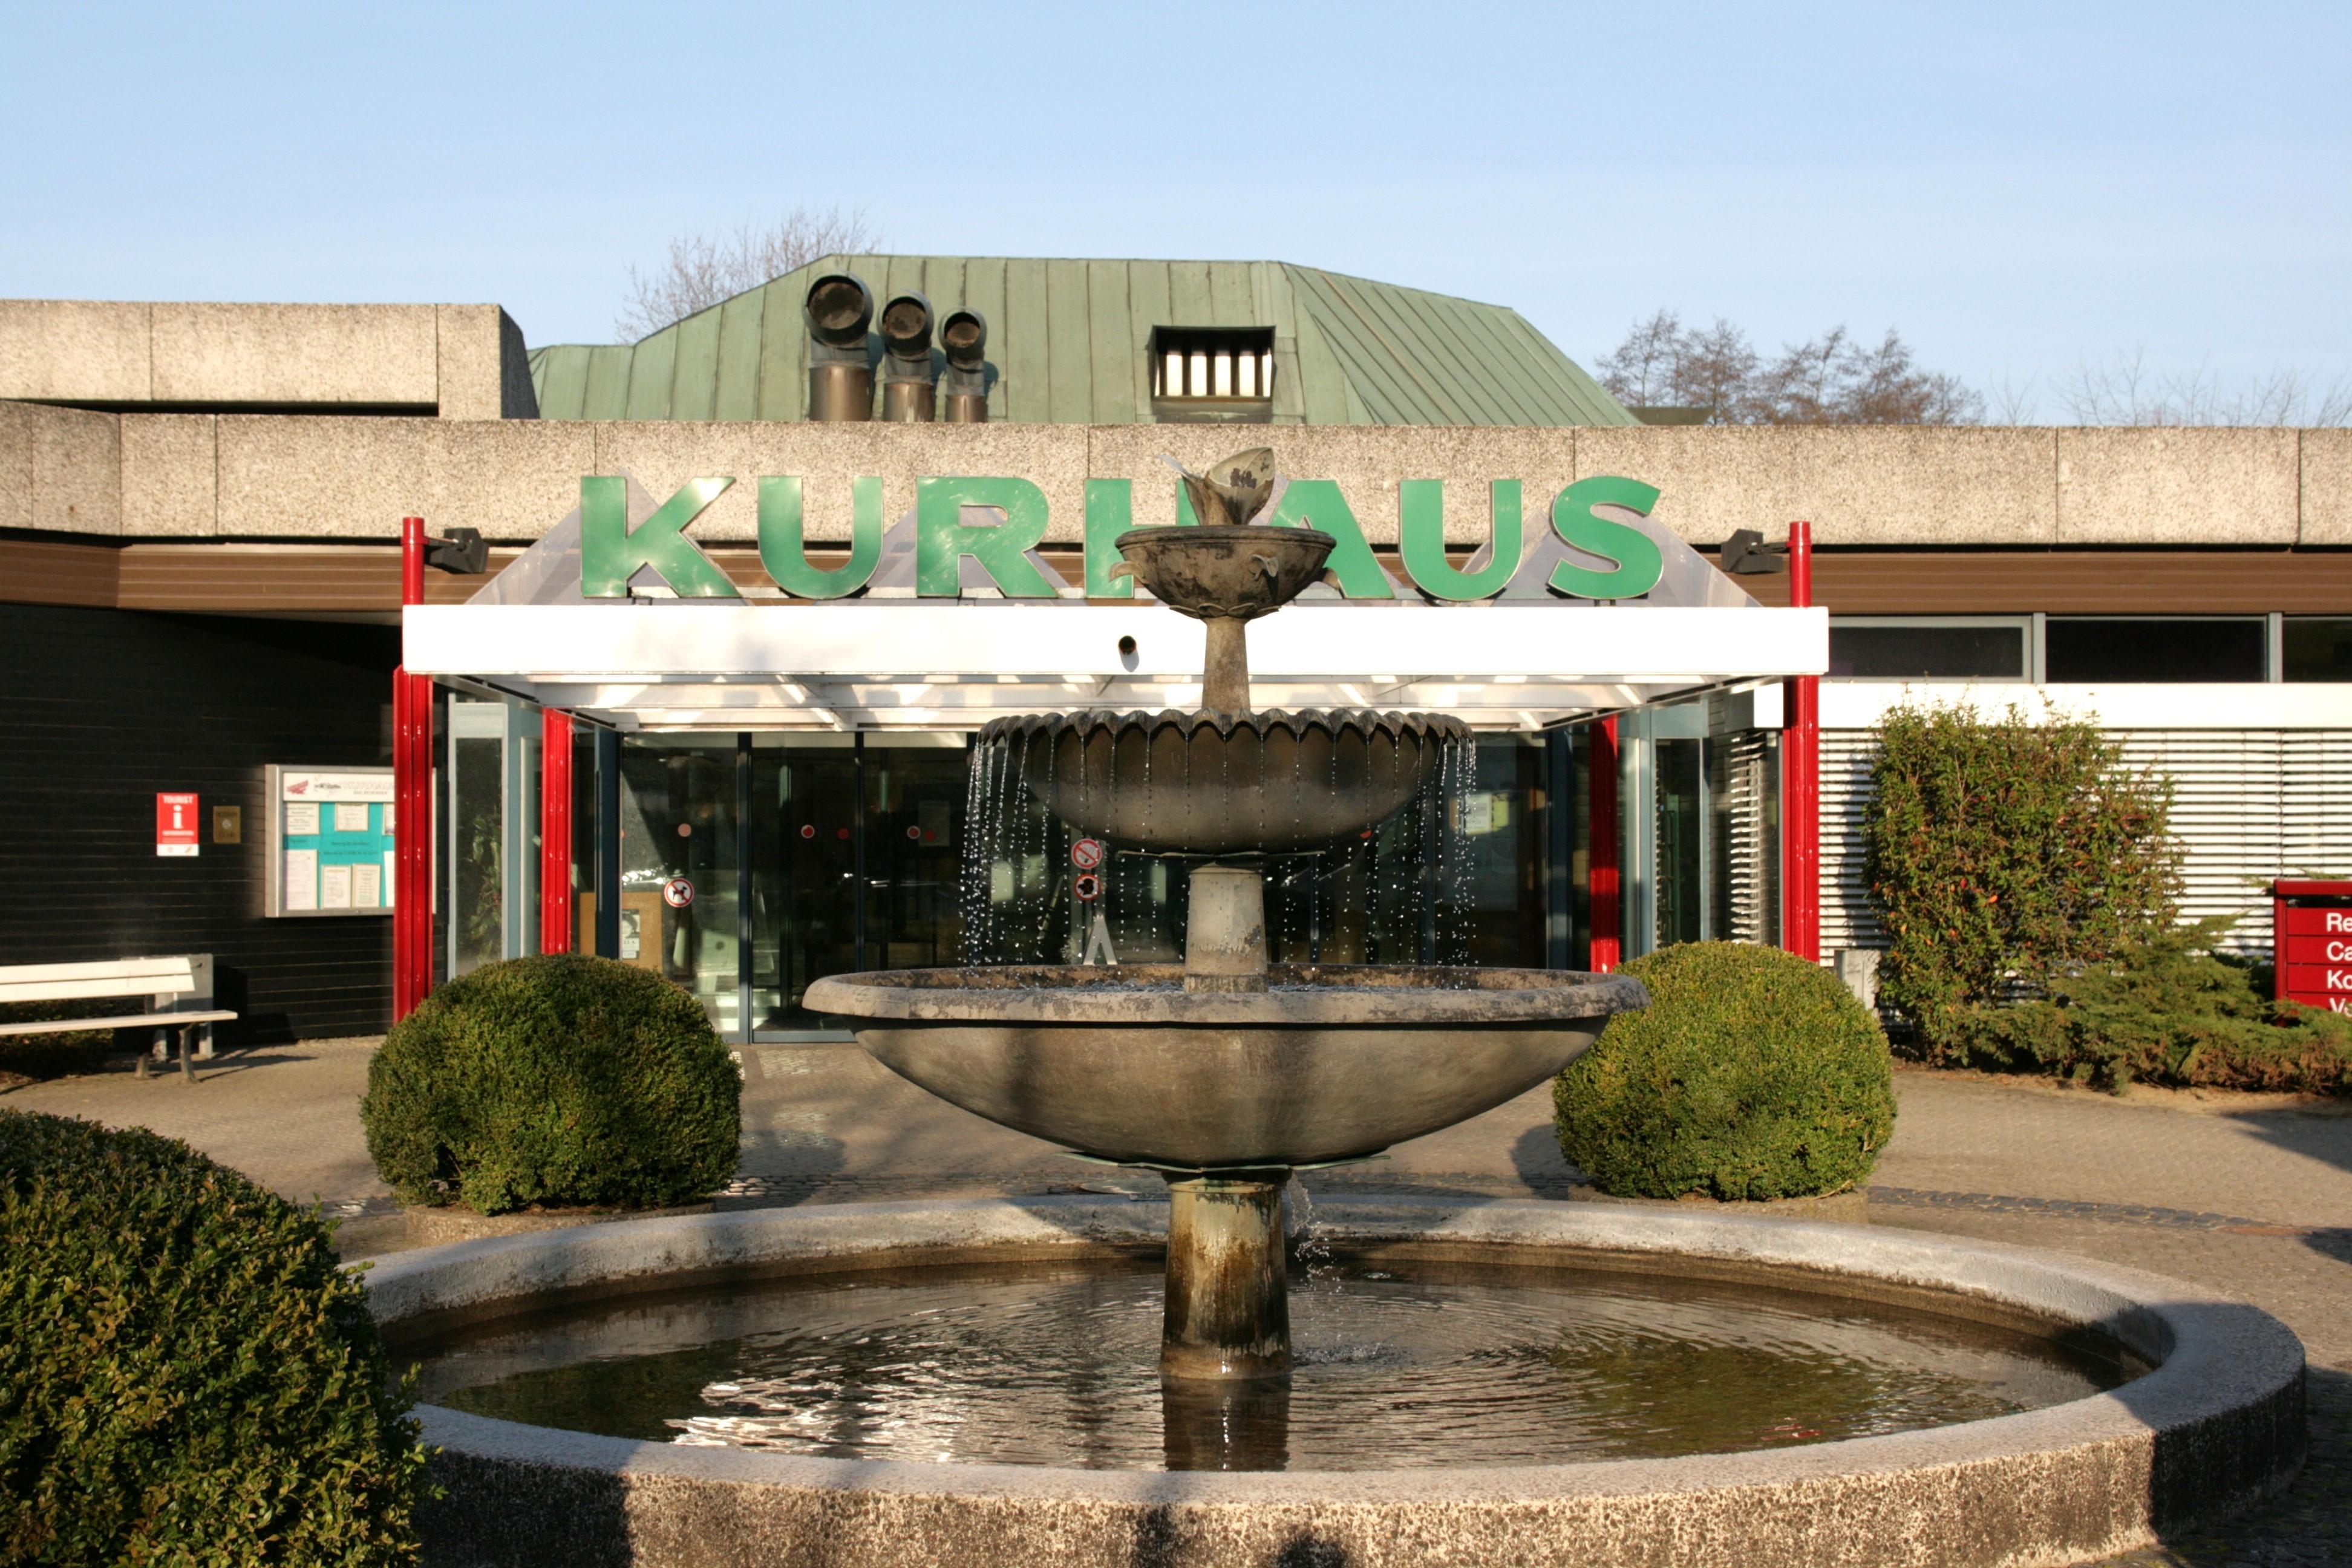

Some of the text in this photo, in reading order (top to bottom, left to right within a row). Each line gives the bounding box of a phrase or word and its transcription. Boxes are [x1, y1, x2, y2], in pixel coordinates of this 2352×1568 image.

[580, 475, 1664, 602] KURHAUS
[162, 794, 194, 804] TOURIST
[2326, 912, 2352, 932] Re
[2326, 941, 2352, 961] Ca
[2327, 970, 2352, 990] Ko
